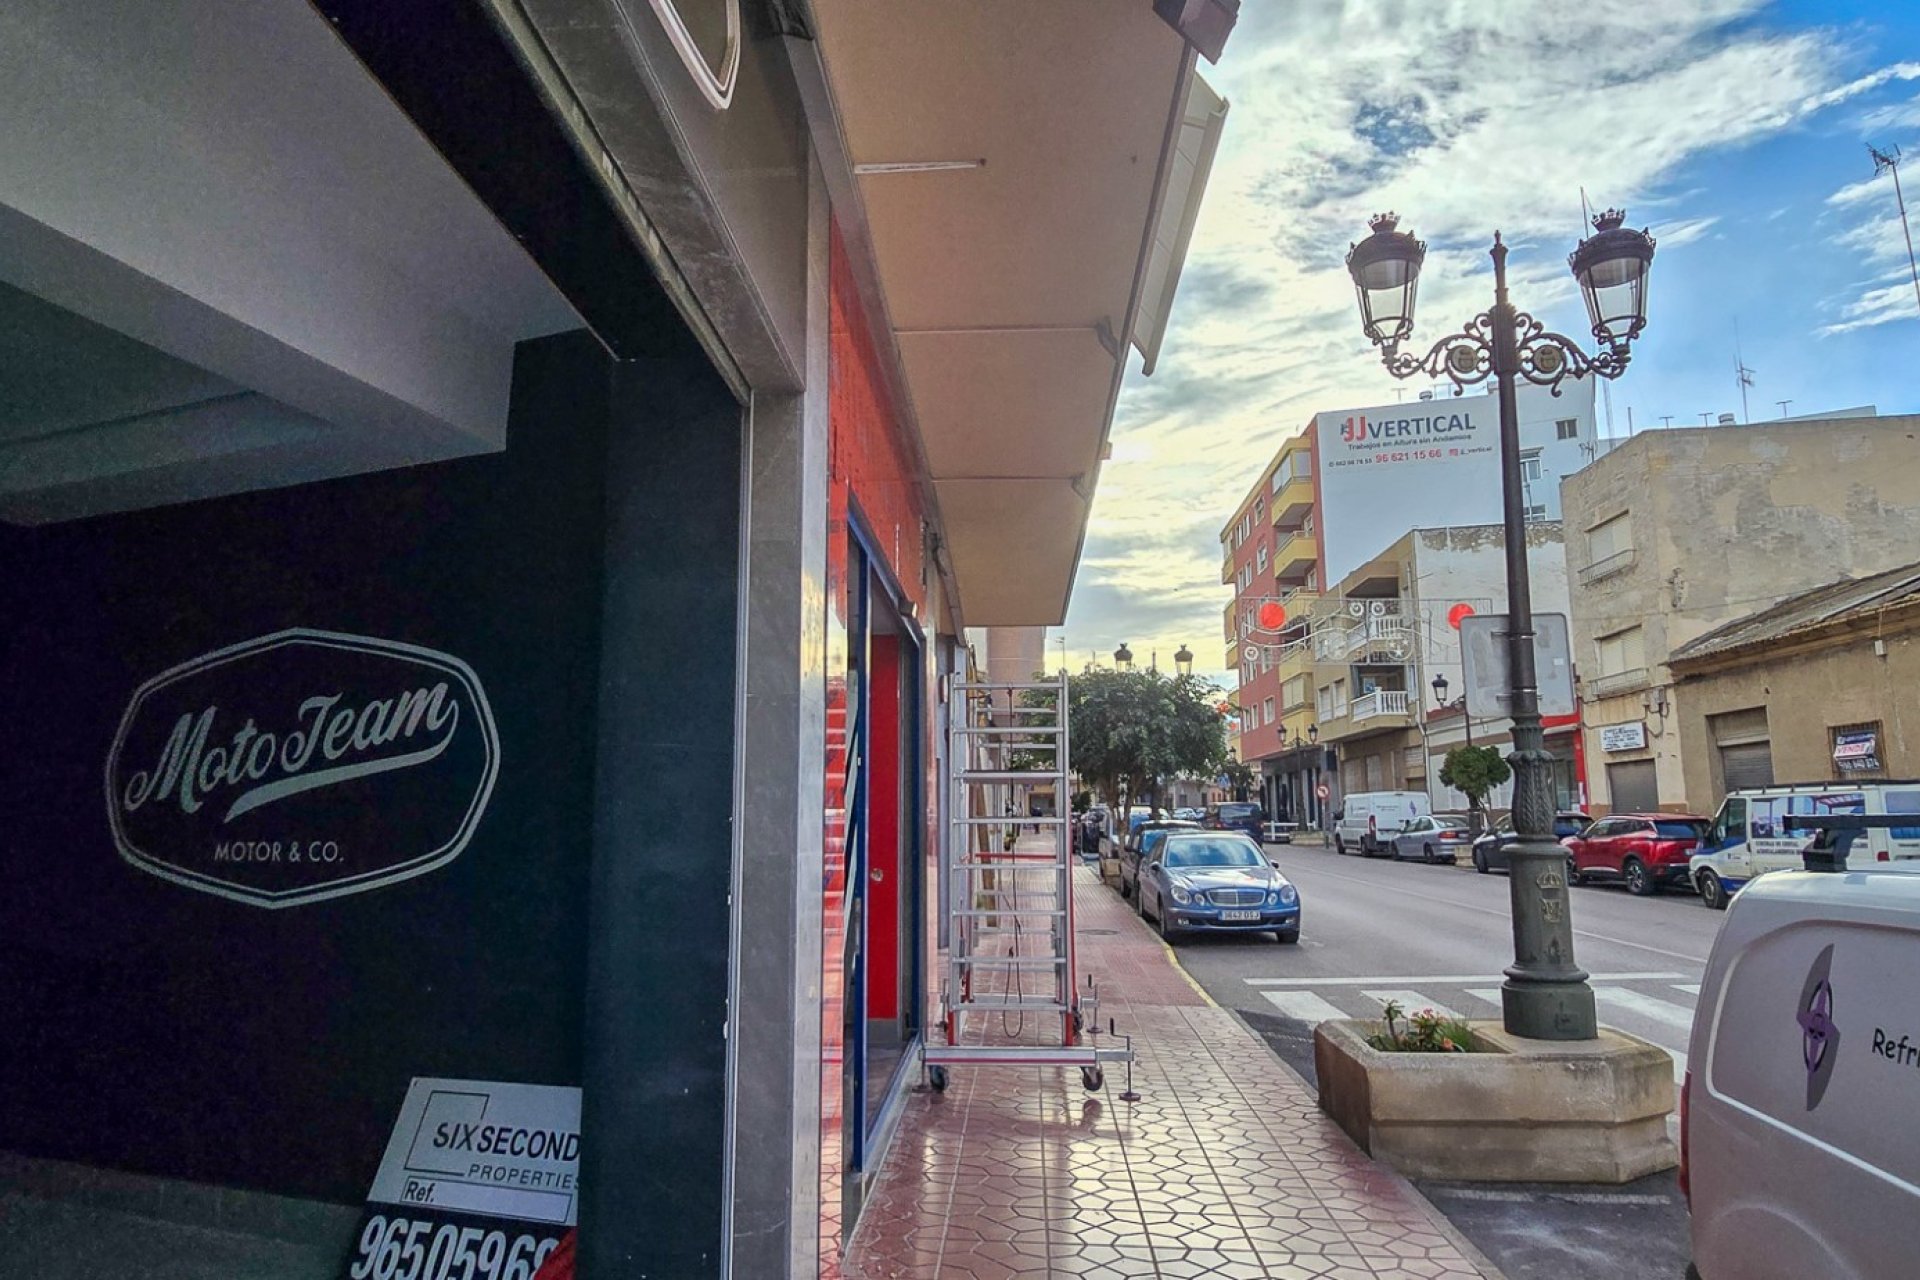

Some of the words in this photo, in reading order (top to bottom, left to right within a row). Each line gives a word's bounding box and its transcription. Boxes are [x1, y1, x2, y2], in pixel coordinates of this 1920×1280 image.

[215, 841, 281, 862] MOTOR
[288, 841, 302, 862] &
[309, 841, 345, 863] CO.
[404, 1181, 434, 1203] Ref.
